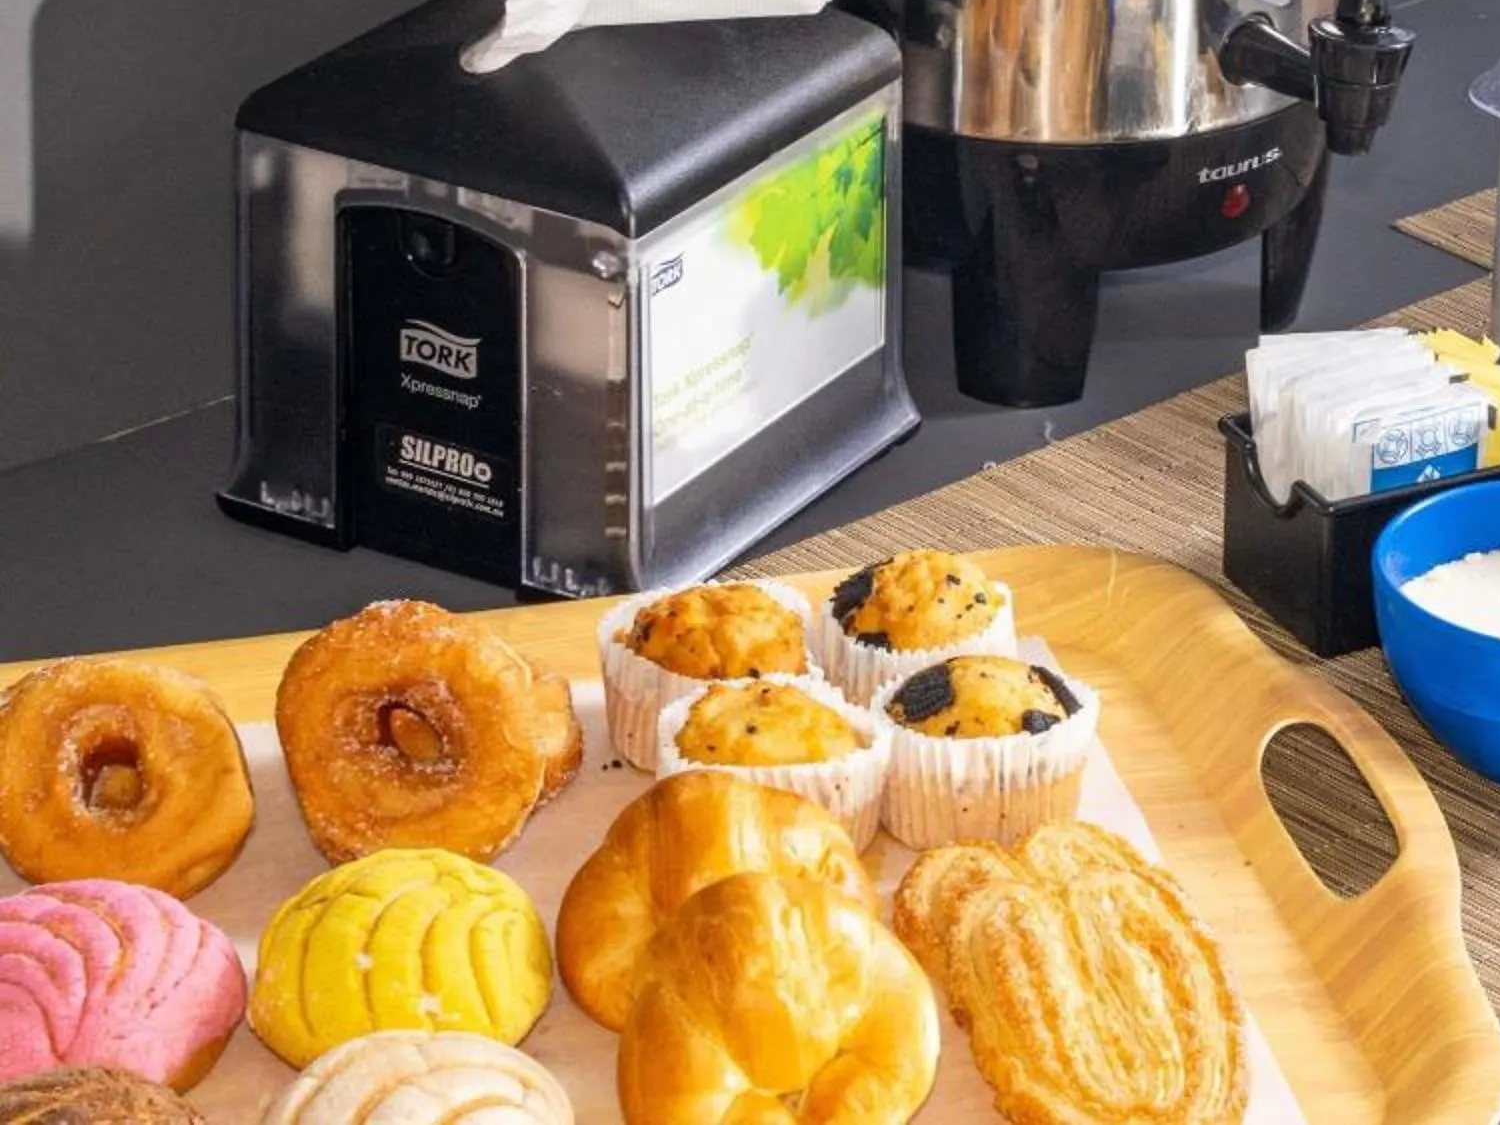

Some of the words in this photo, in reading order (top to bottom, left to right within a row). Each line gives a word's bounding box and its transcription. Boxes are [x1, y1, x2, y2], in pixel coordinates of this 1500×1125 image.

[1196, 146, 1284, 184] taurus
[404, 334, 474, 373] TORK
[400, 372, 482, 409] Xpressnap
